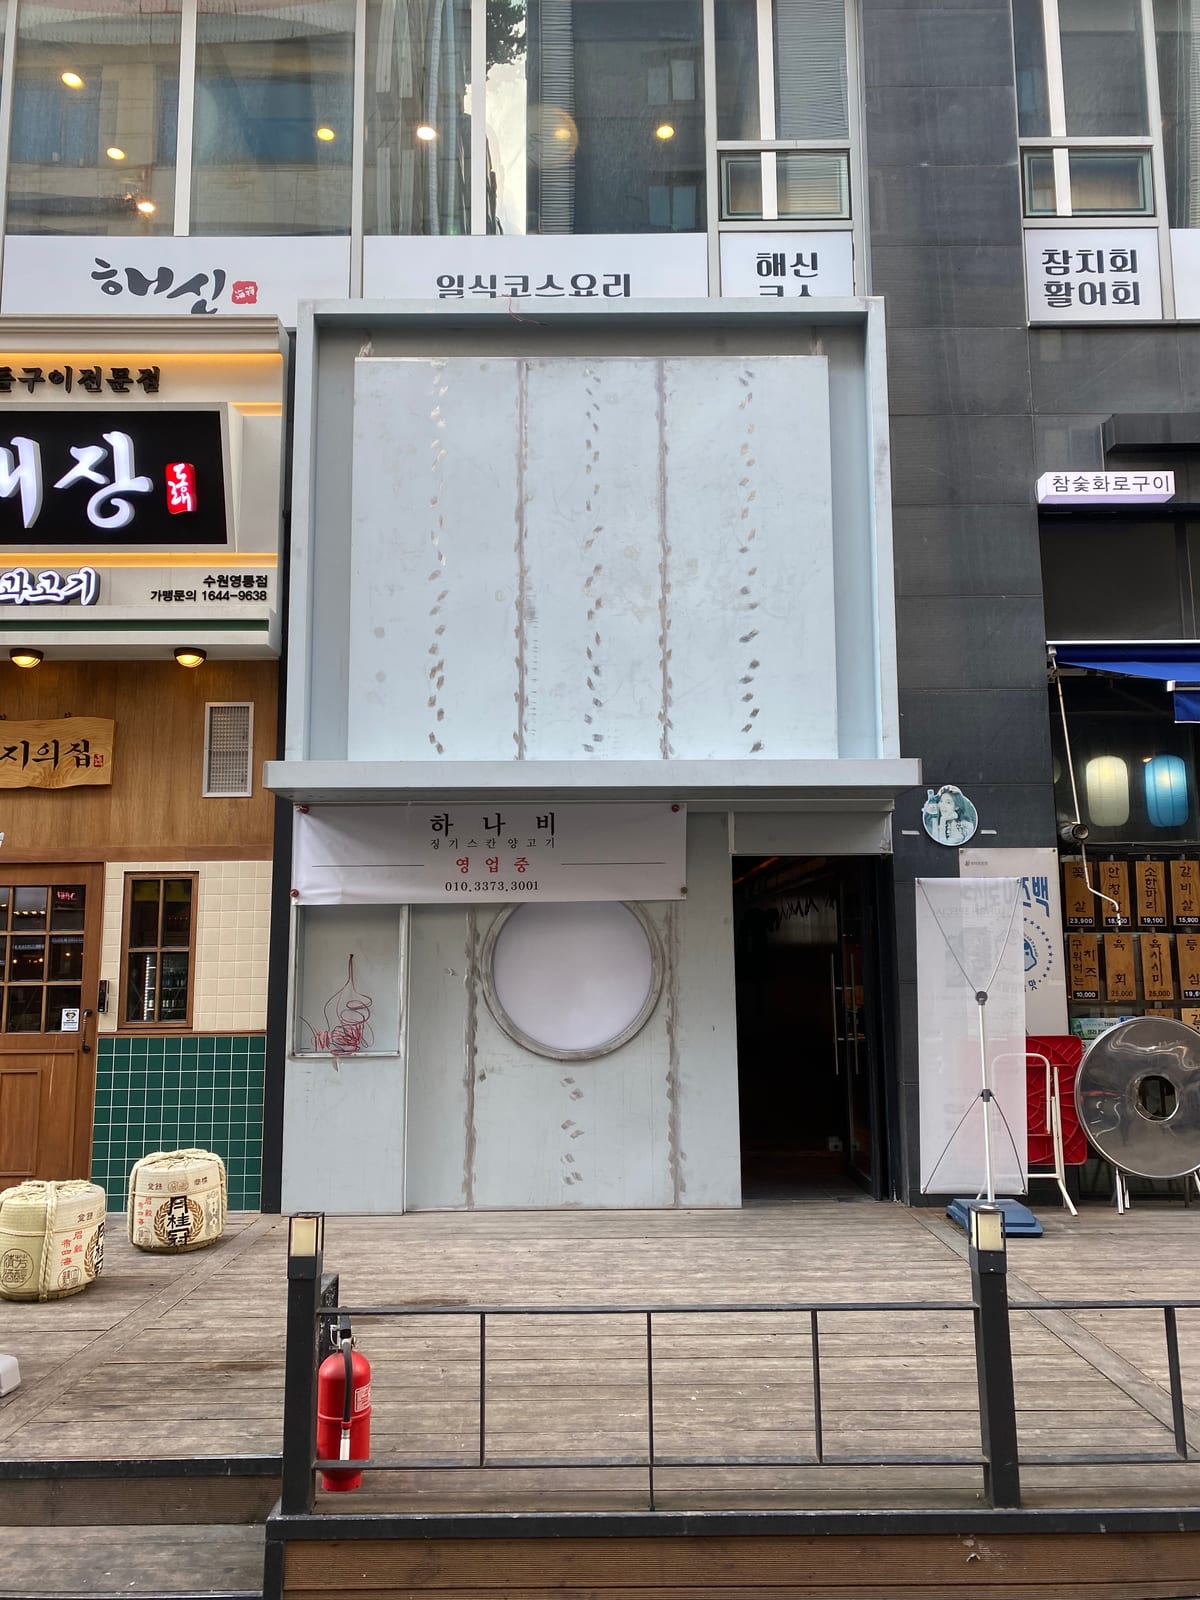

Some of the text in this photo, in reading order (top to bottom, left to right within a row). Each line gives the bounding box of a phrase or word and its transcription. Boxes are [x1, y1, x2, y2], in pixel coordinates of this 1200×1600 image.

[756, 252, 819, 278] 해신
[1042, 249, 1138, 276] 참치회
[91, 257, 226, 314] 해신
[436, 274, 631, 299] 일식코스요리
[1044, 281, 1140, 308] 활어회
[1052, 475, 1170, 493] 참숯화로구이
[203, 575, 268, 588] 수원영통점
[150, 590, 267, 602] 가맹문의 1644-9638
[445, 881, 539, 892] 010.3373.3001
[1179, 865, 1193, 912] 갈비살
[1113, 939, 1126, 986] 육회
